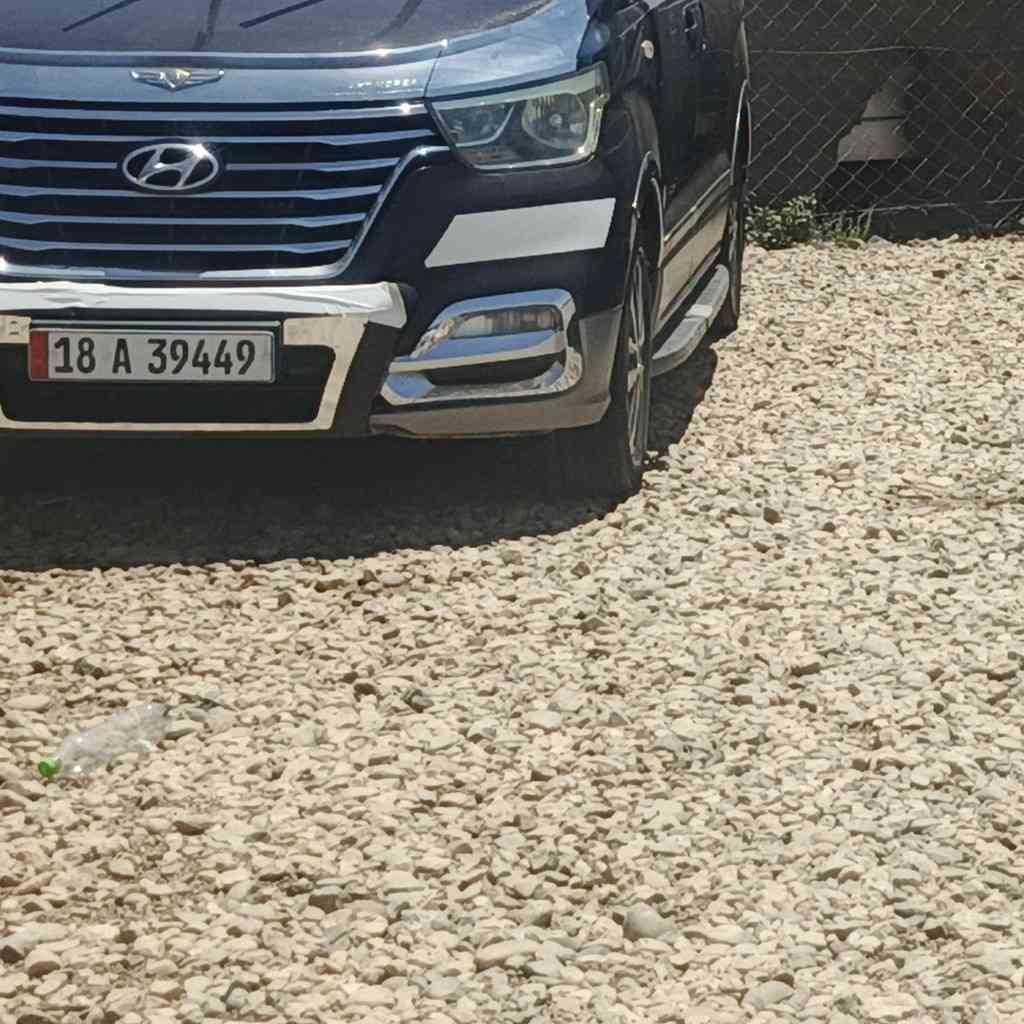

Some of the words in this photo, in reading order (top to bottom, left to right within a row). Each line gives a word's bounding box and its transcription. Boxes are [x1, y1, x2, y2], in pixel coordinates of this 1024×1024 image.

[55, 337, 96, 374] 18
[112, 339, 131, 374] A
[148, 339, 256, 375] 39449
